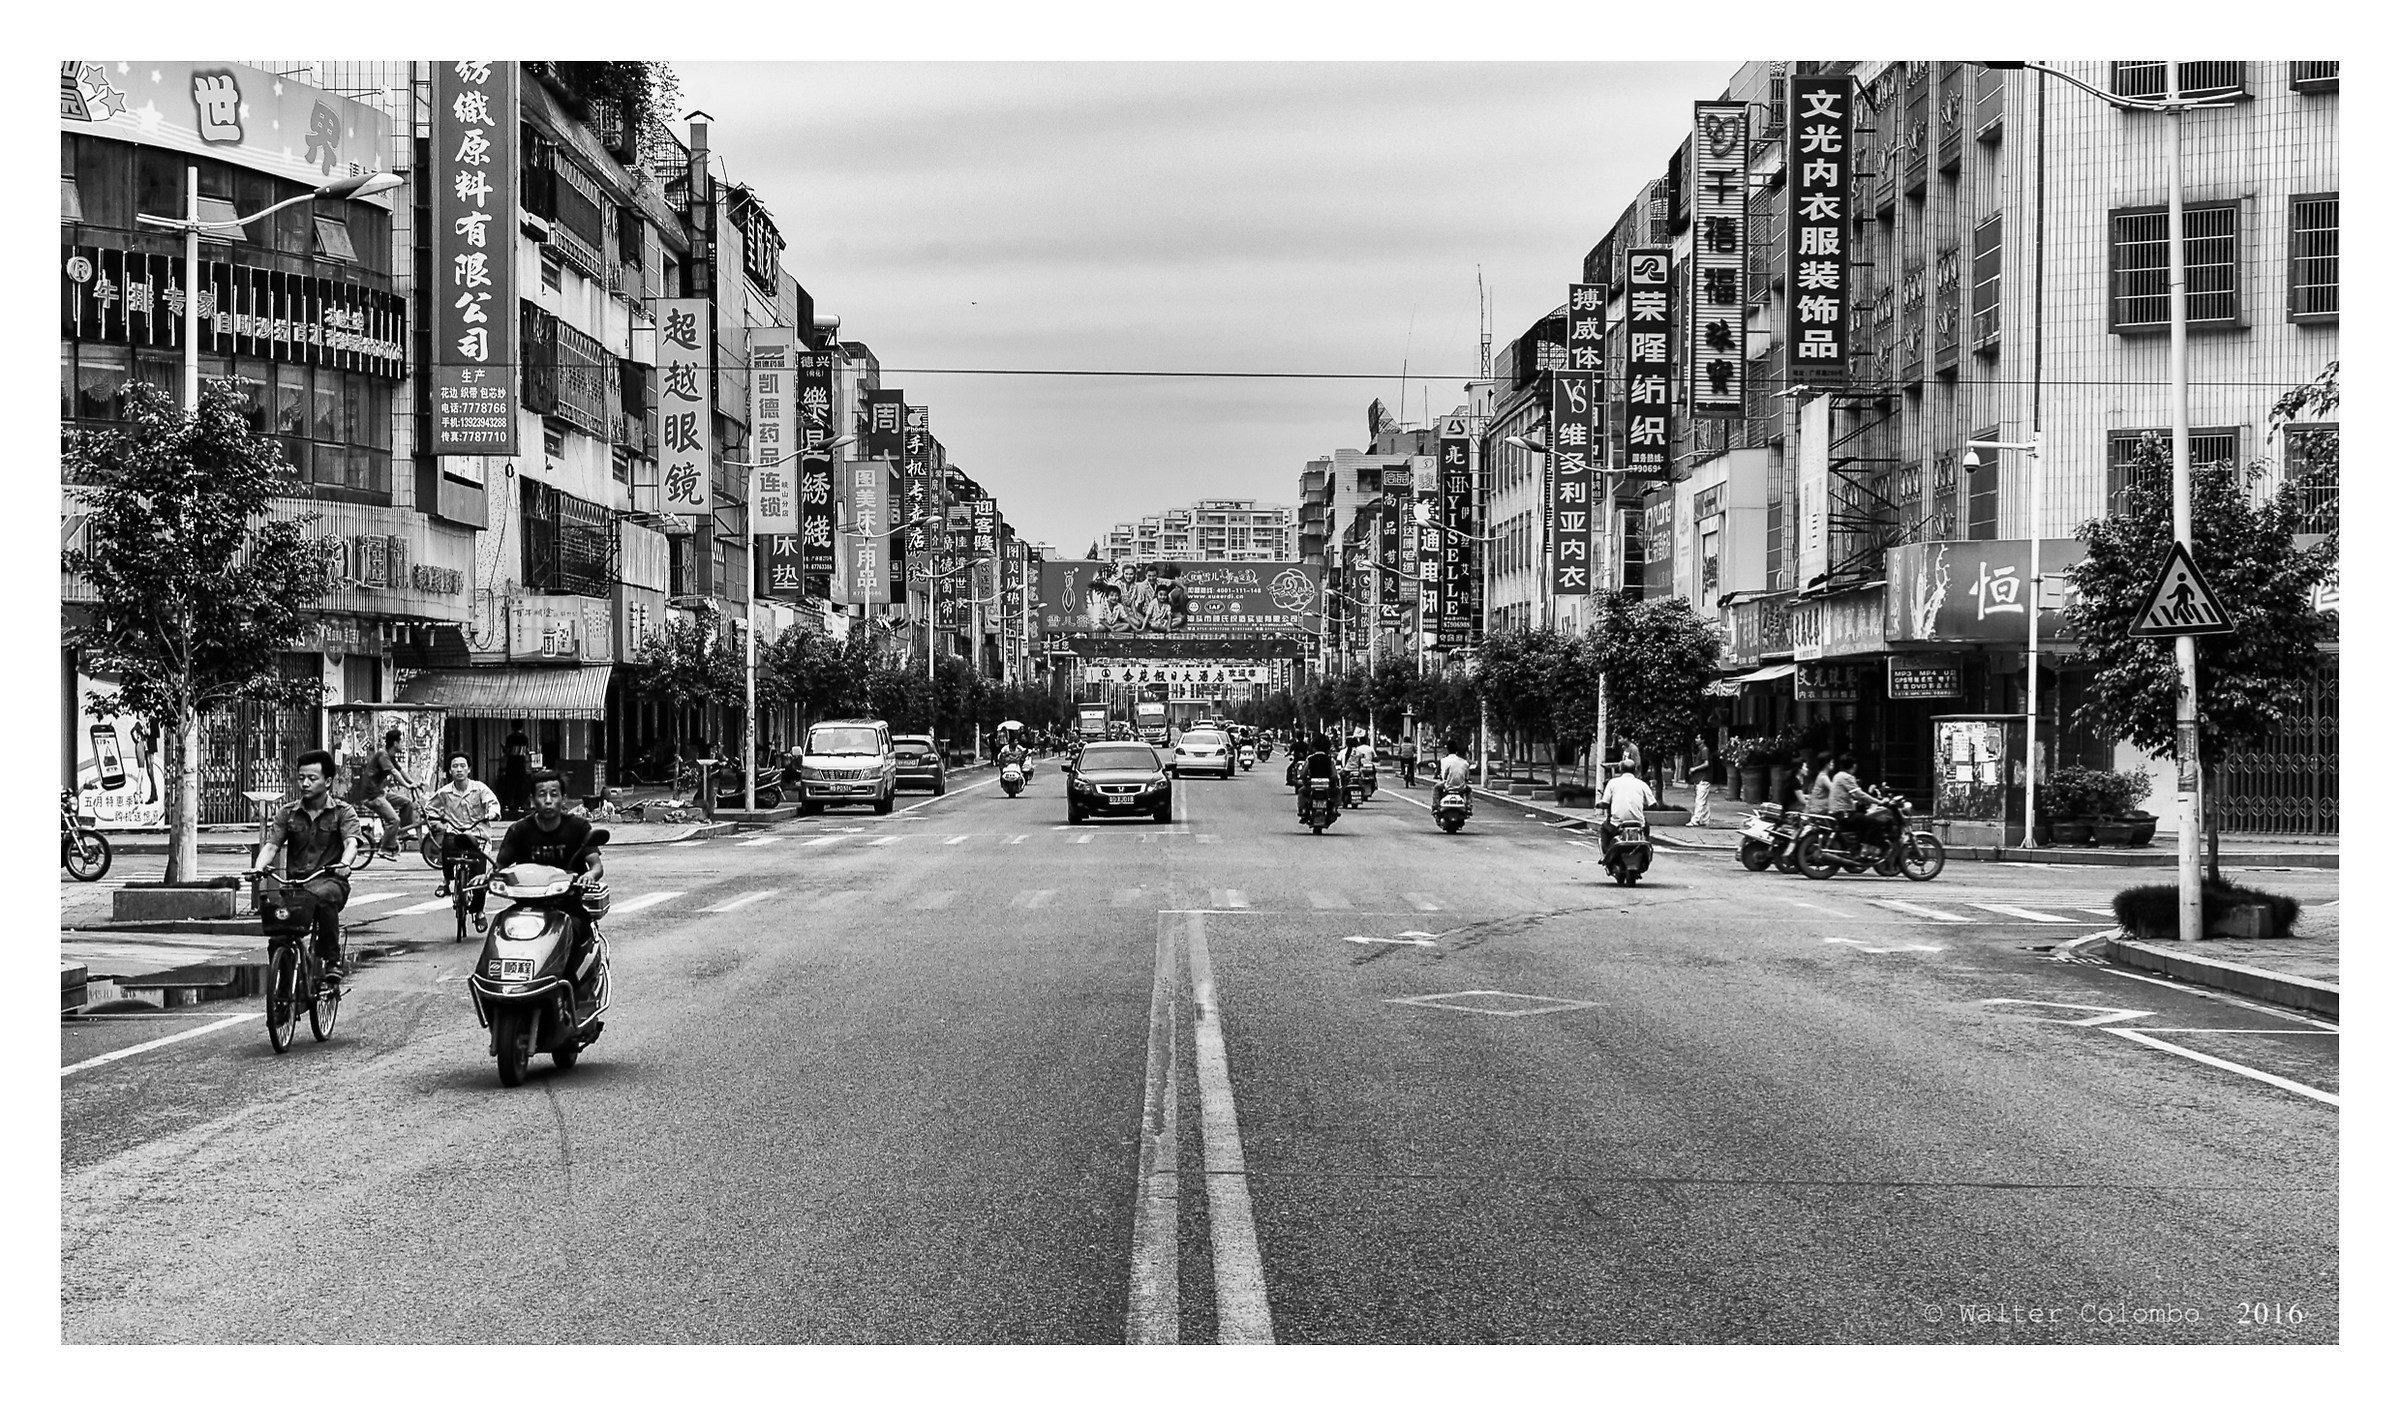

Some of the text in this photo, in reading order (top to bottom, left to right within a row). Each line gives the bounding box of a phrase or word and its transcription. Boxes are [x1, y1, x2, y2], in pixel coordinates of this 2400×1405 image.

[194, 72, 342, 176] 世界
[1797, 89, 1843, 359] 文光内衣服装饰品
[440, 386, 459, 399] 花边
[461, 368, 486, 383] 生产
[1630, 290, 1667, 446] 荣隆纺织
[759, 373, 781, 518] 凯德药品连锁
[905, 433, 927, 549] 手机专卖店
[974, 500, 994, 552] 迎客隆
[1445, 495, 1459, 615] YISELLE
[1558, 422, 1588, 588] 维多利亚内衣
